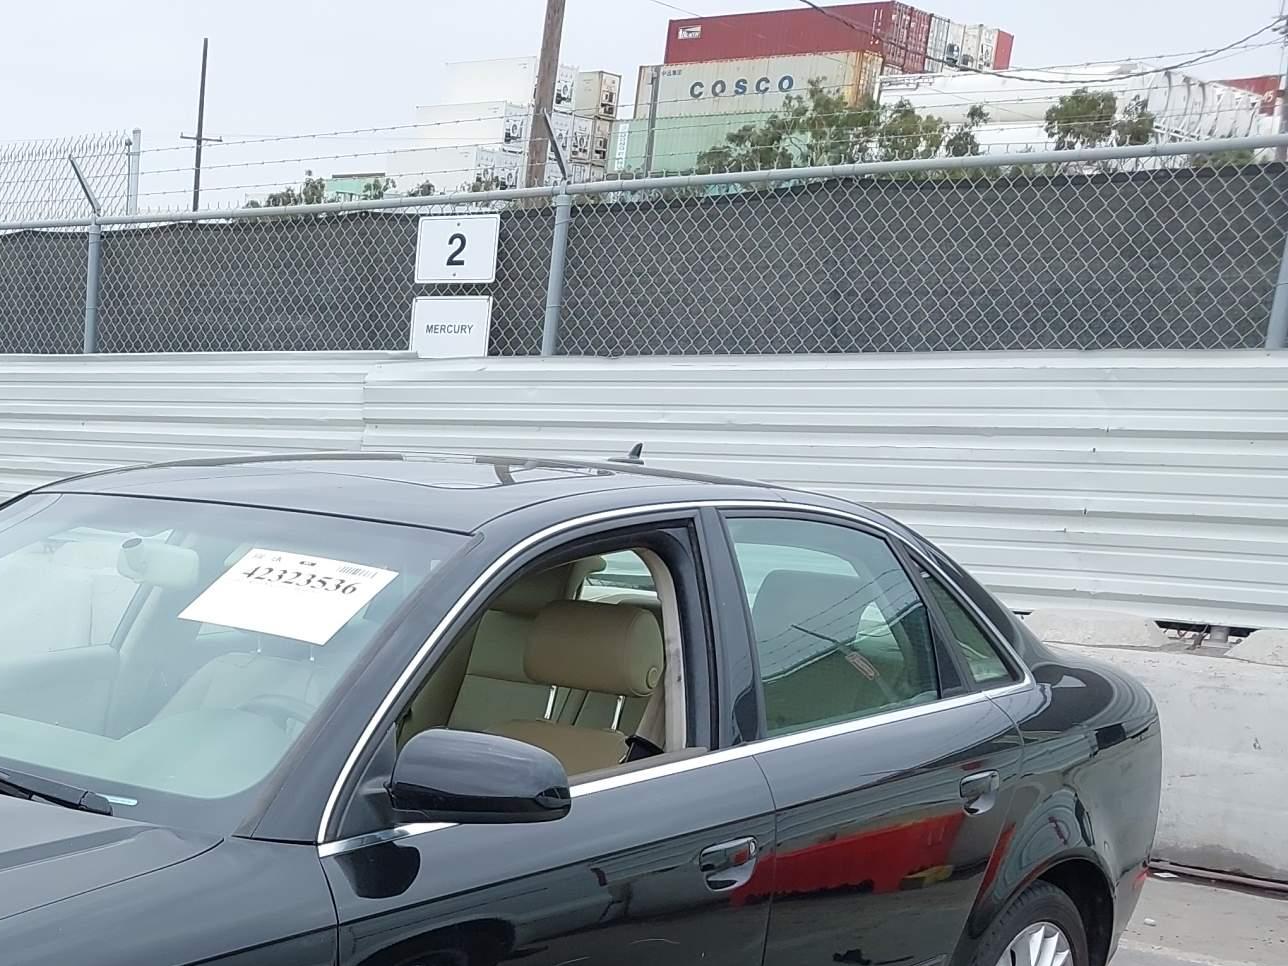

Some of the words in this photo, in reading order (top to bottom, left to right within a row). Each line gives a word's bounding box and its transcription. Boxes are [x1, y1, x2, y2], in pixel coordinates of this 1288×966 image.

[689, 74, 795, 99] COSCO
[445, 232, 467, 266] 2
[425, 324, 474, 334] MERCURY
[242, 565, 362, 595] 42323536
